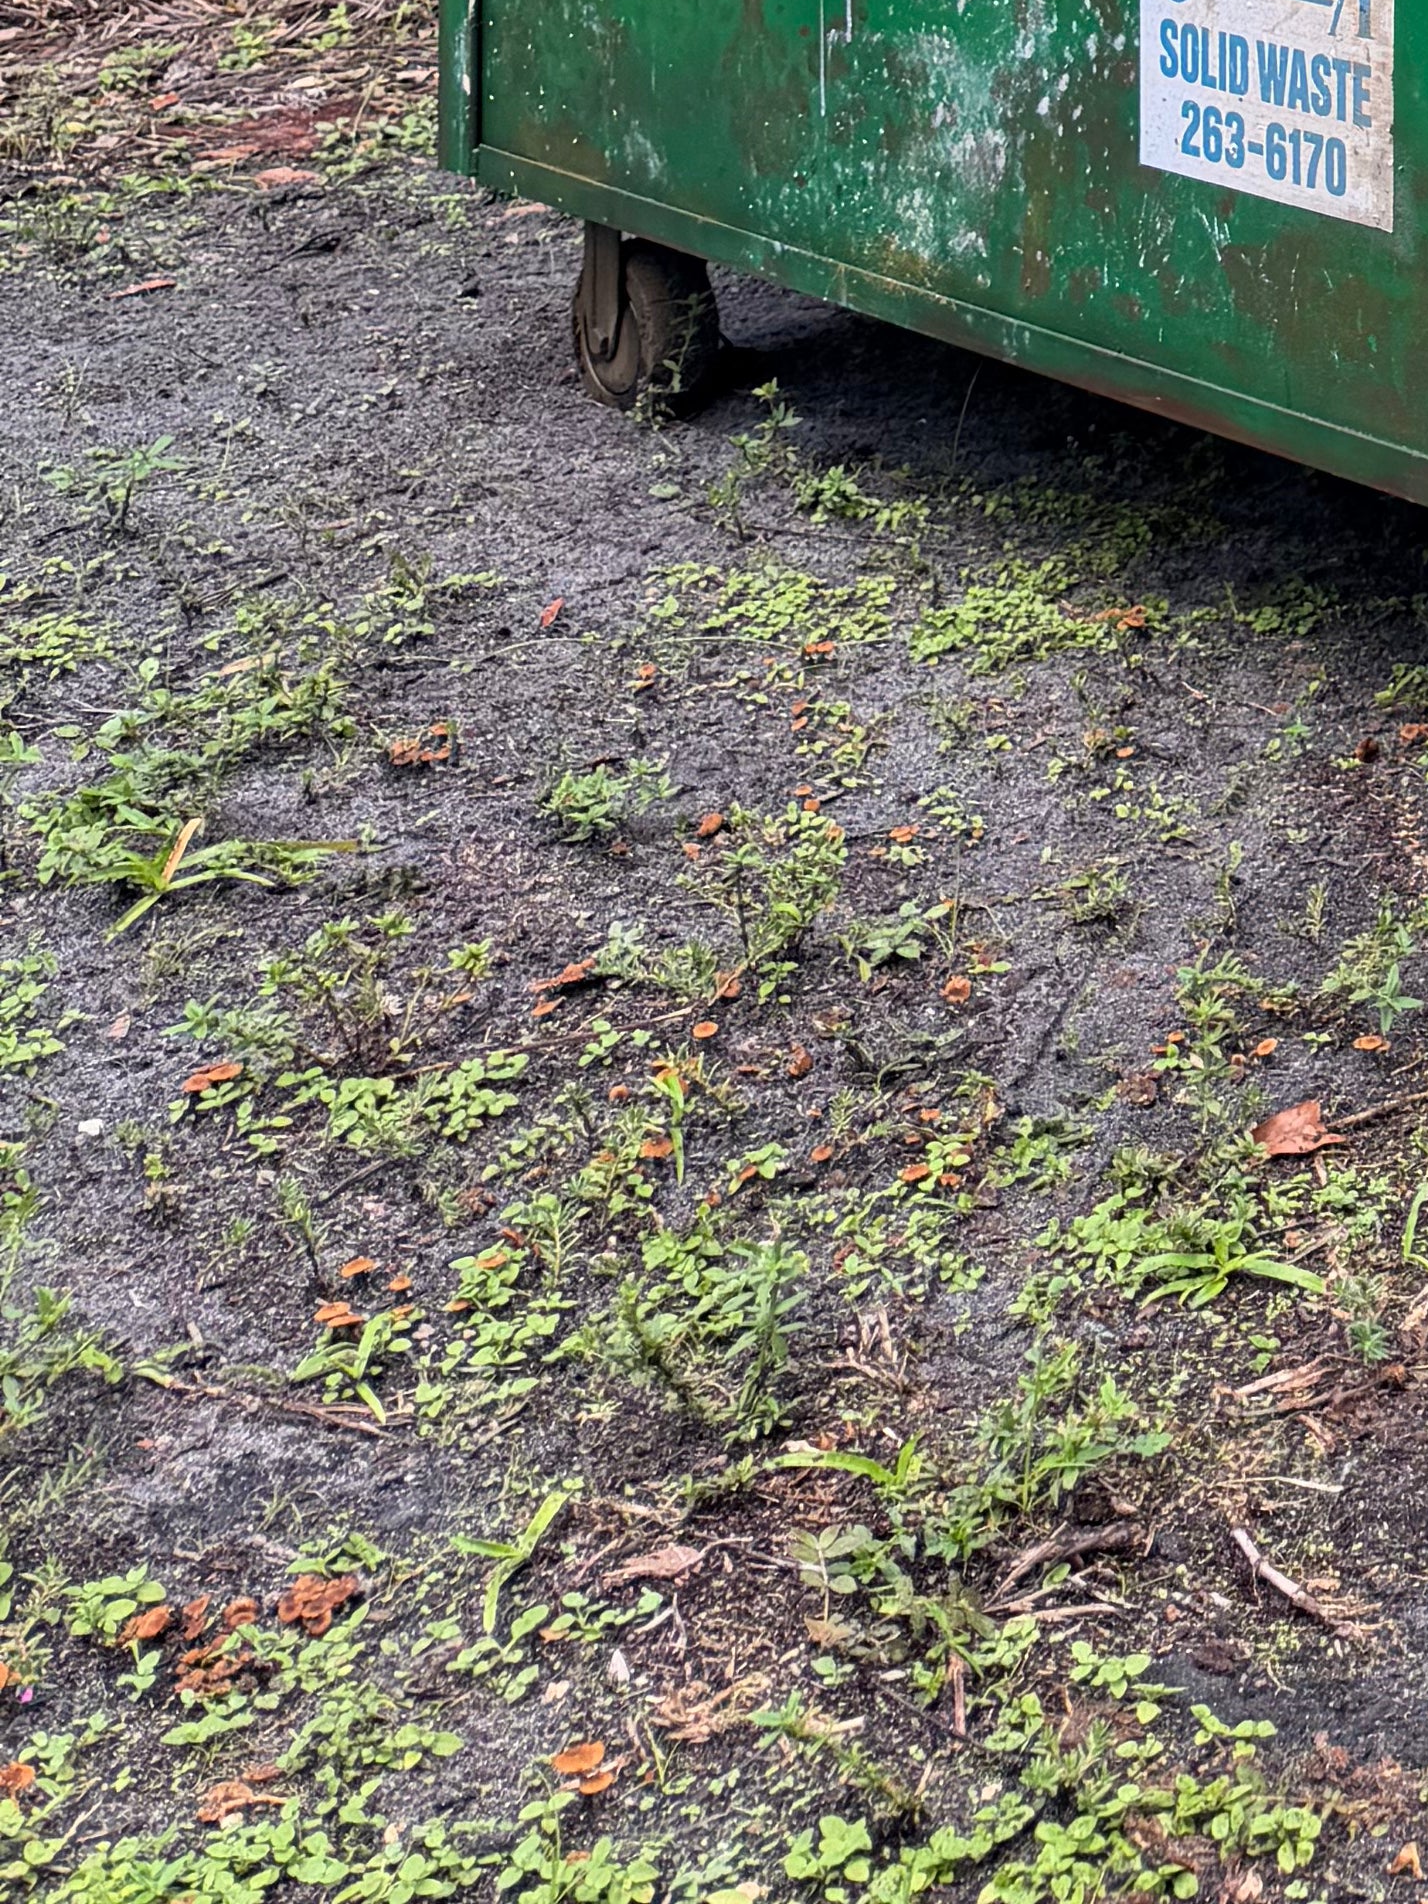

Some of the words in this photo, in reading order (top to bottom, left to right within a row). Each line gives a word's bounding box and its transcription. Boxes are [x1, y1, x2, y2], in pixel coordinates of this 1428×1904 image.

[1159, 17, 1250, 96] SOLID
[1256, 39, 1373, 129] WASTE
[1180, 99, 1348, 198] 263-6170
